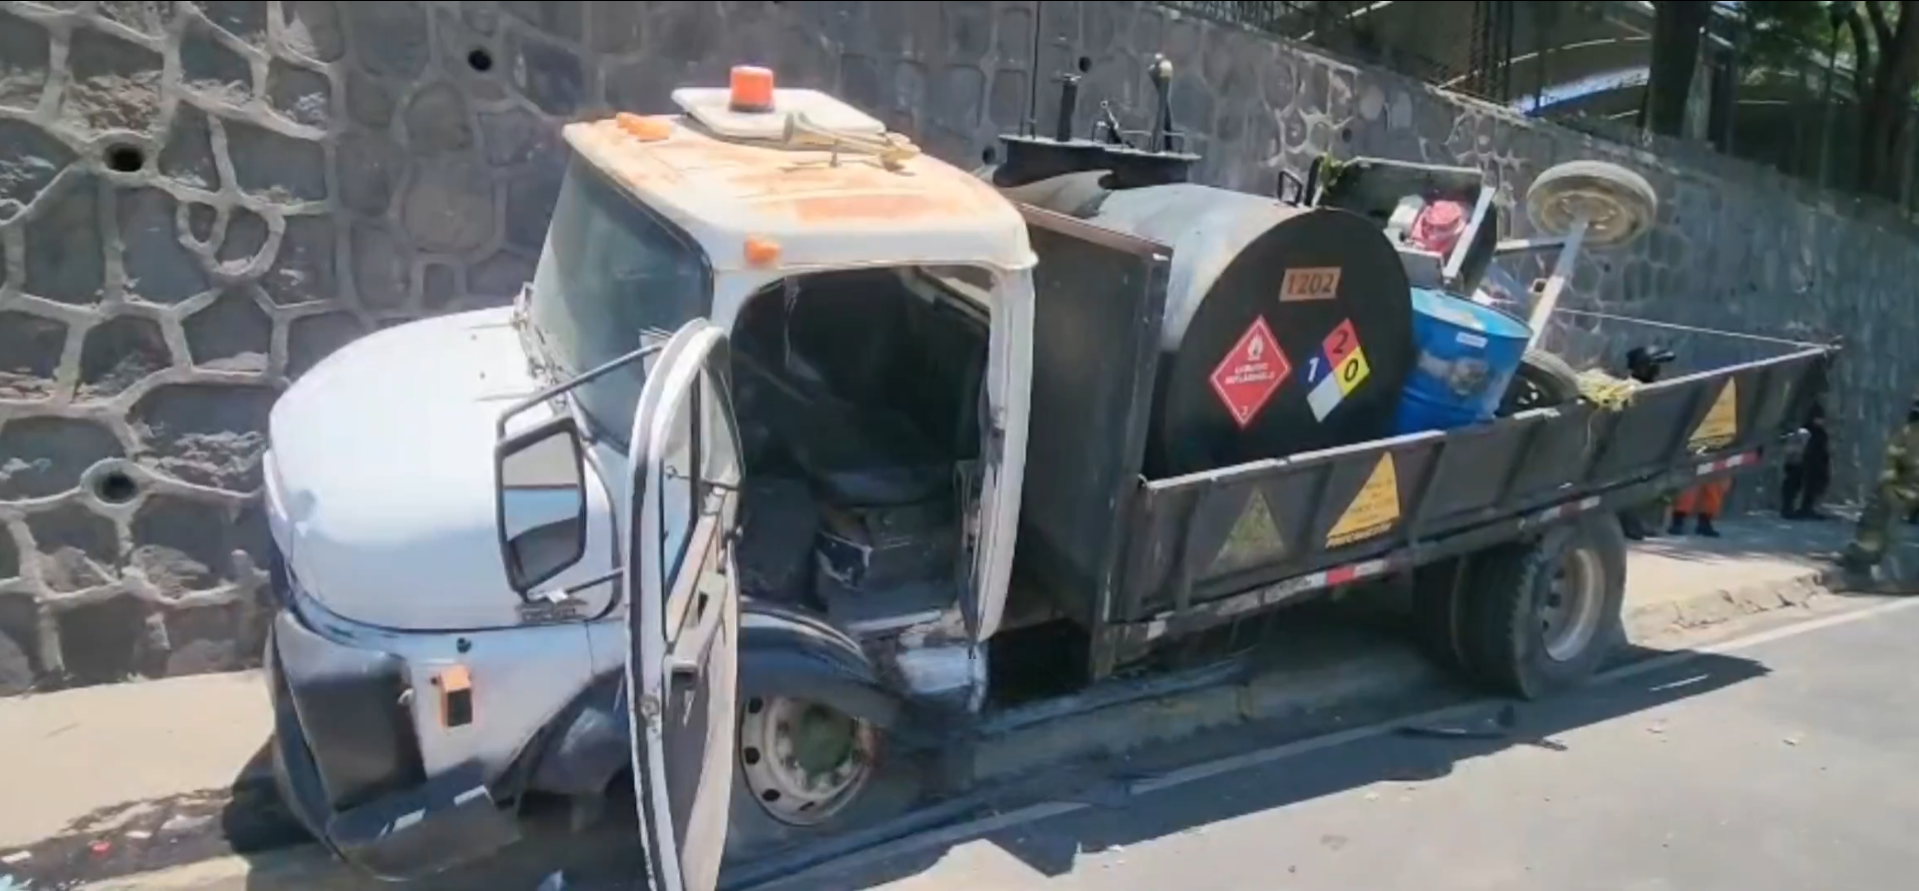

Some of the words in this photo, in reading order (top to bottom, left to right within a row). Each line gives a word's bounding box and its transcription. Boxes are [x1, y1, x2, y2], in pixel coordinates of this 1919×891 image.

[1287, 272, 1335, 295] 1202
[1332, 328, 1349, 354] 2
[1308, 357, 1320, 382] 1
[1343, 358, 1359, 383] 0
